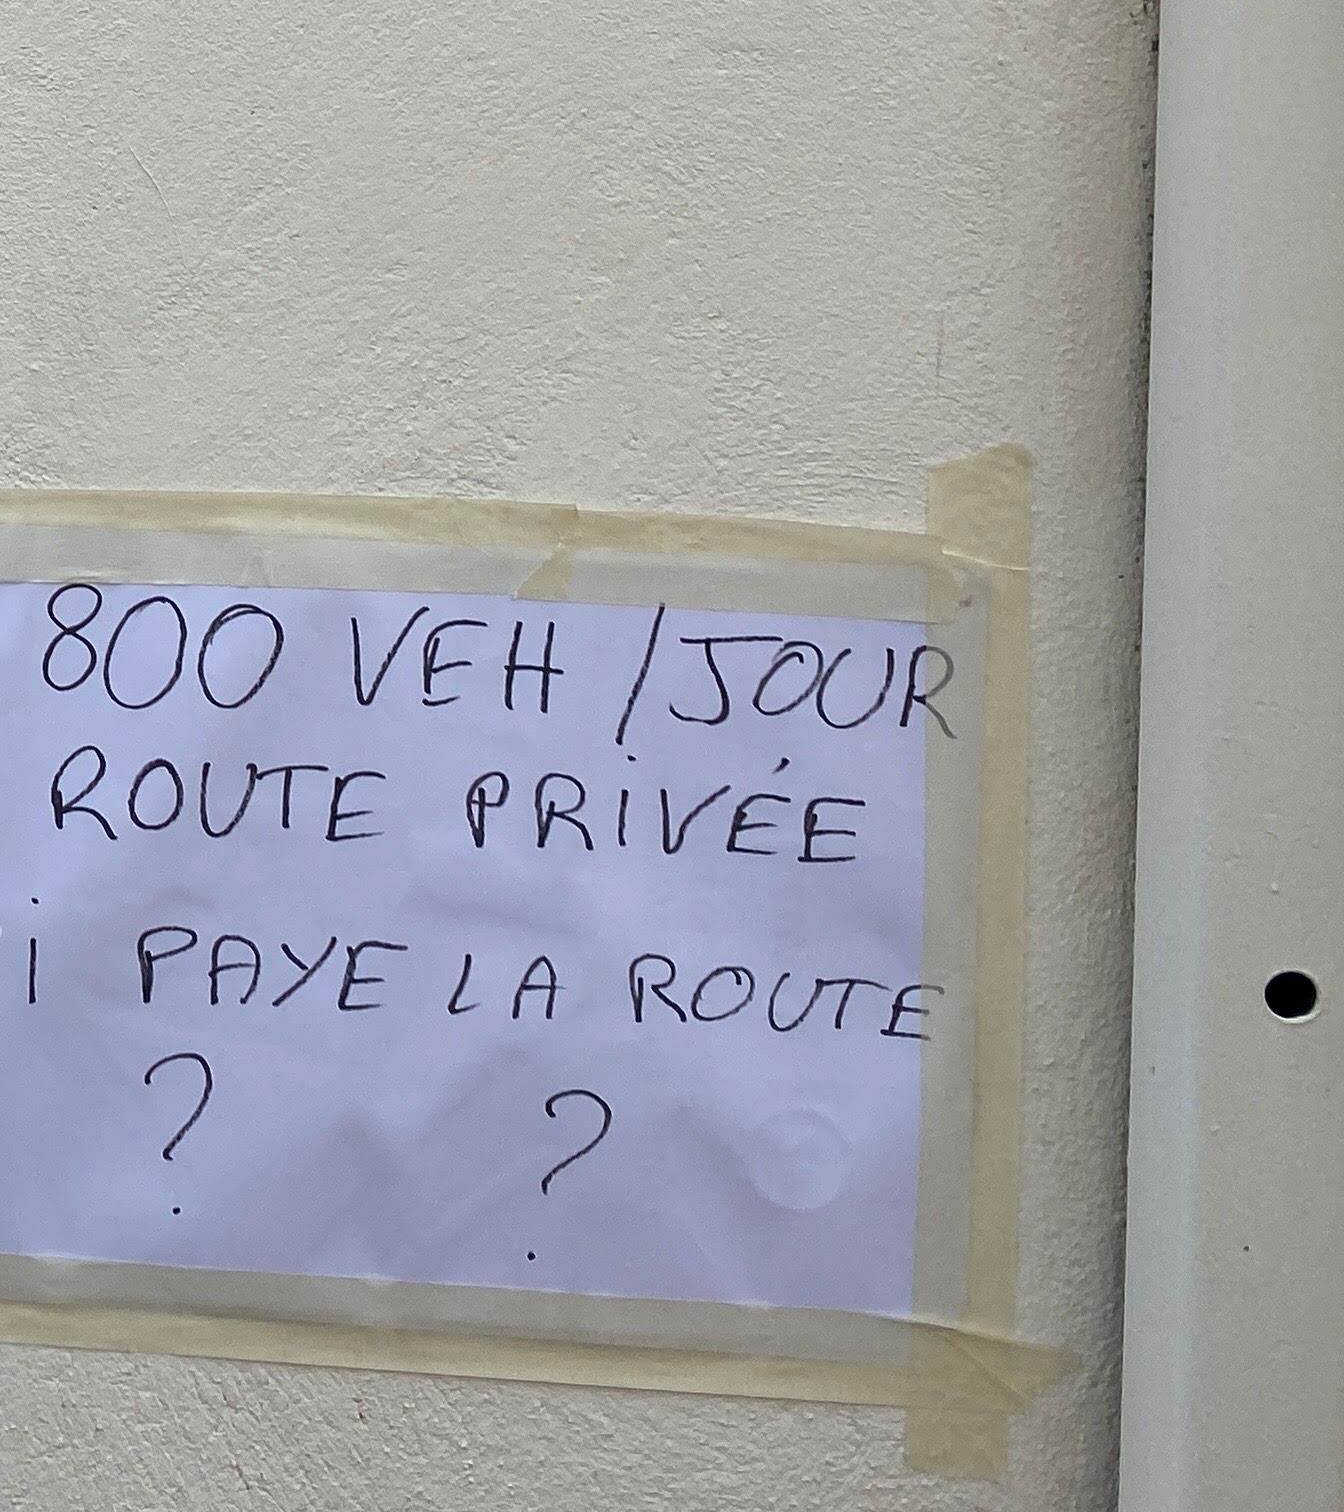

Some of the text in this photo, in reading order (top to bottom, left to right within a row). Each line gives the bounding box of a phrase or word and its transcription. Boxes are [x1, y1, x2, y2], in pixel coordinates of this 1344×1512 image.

[43, 583, 284, 709] 800
[351, 607, 564, 713] VEH
[51, 746, 385, 842] ROUTE
[137, 926, 408, 1011] PAYE
[448, 954, 557, 1019] LA
[629, 953, 944, 1040] ROUTE
[145, 1053, 613, 1262] ? ?
